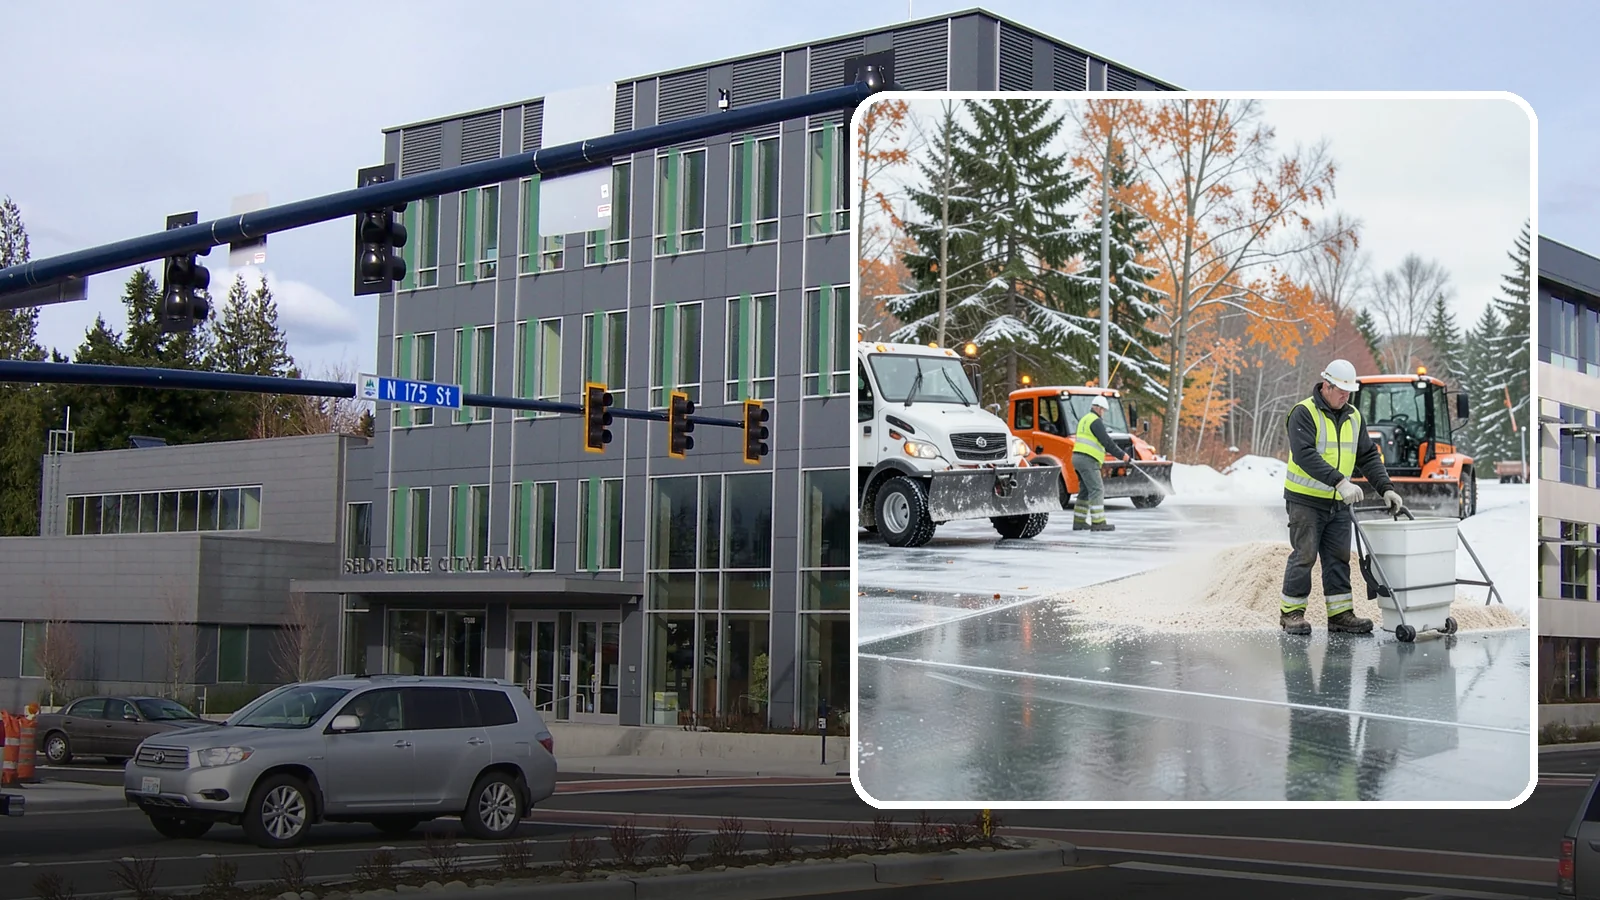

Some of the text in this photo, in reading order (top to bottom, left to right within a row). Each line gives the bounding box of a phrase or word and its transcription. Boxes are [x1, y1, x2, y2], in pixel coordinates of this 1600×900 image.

[387, 380, 451, 406] N 175 St
[345, 556, 525, 574] SHORELINE CITY HALL
